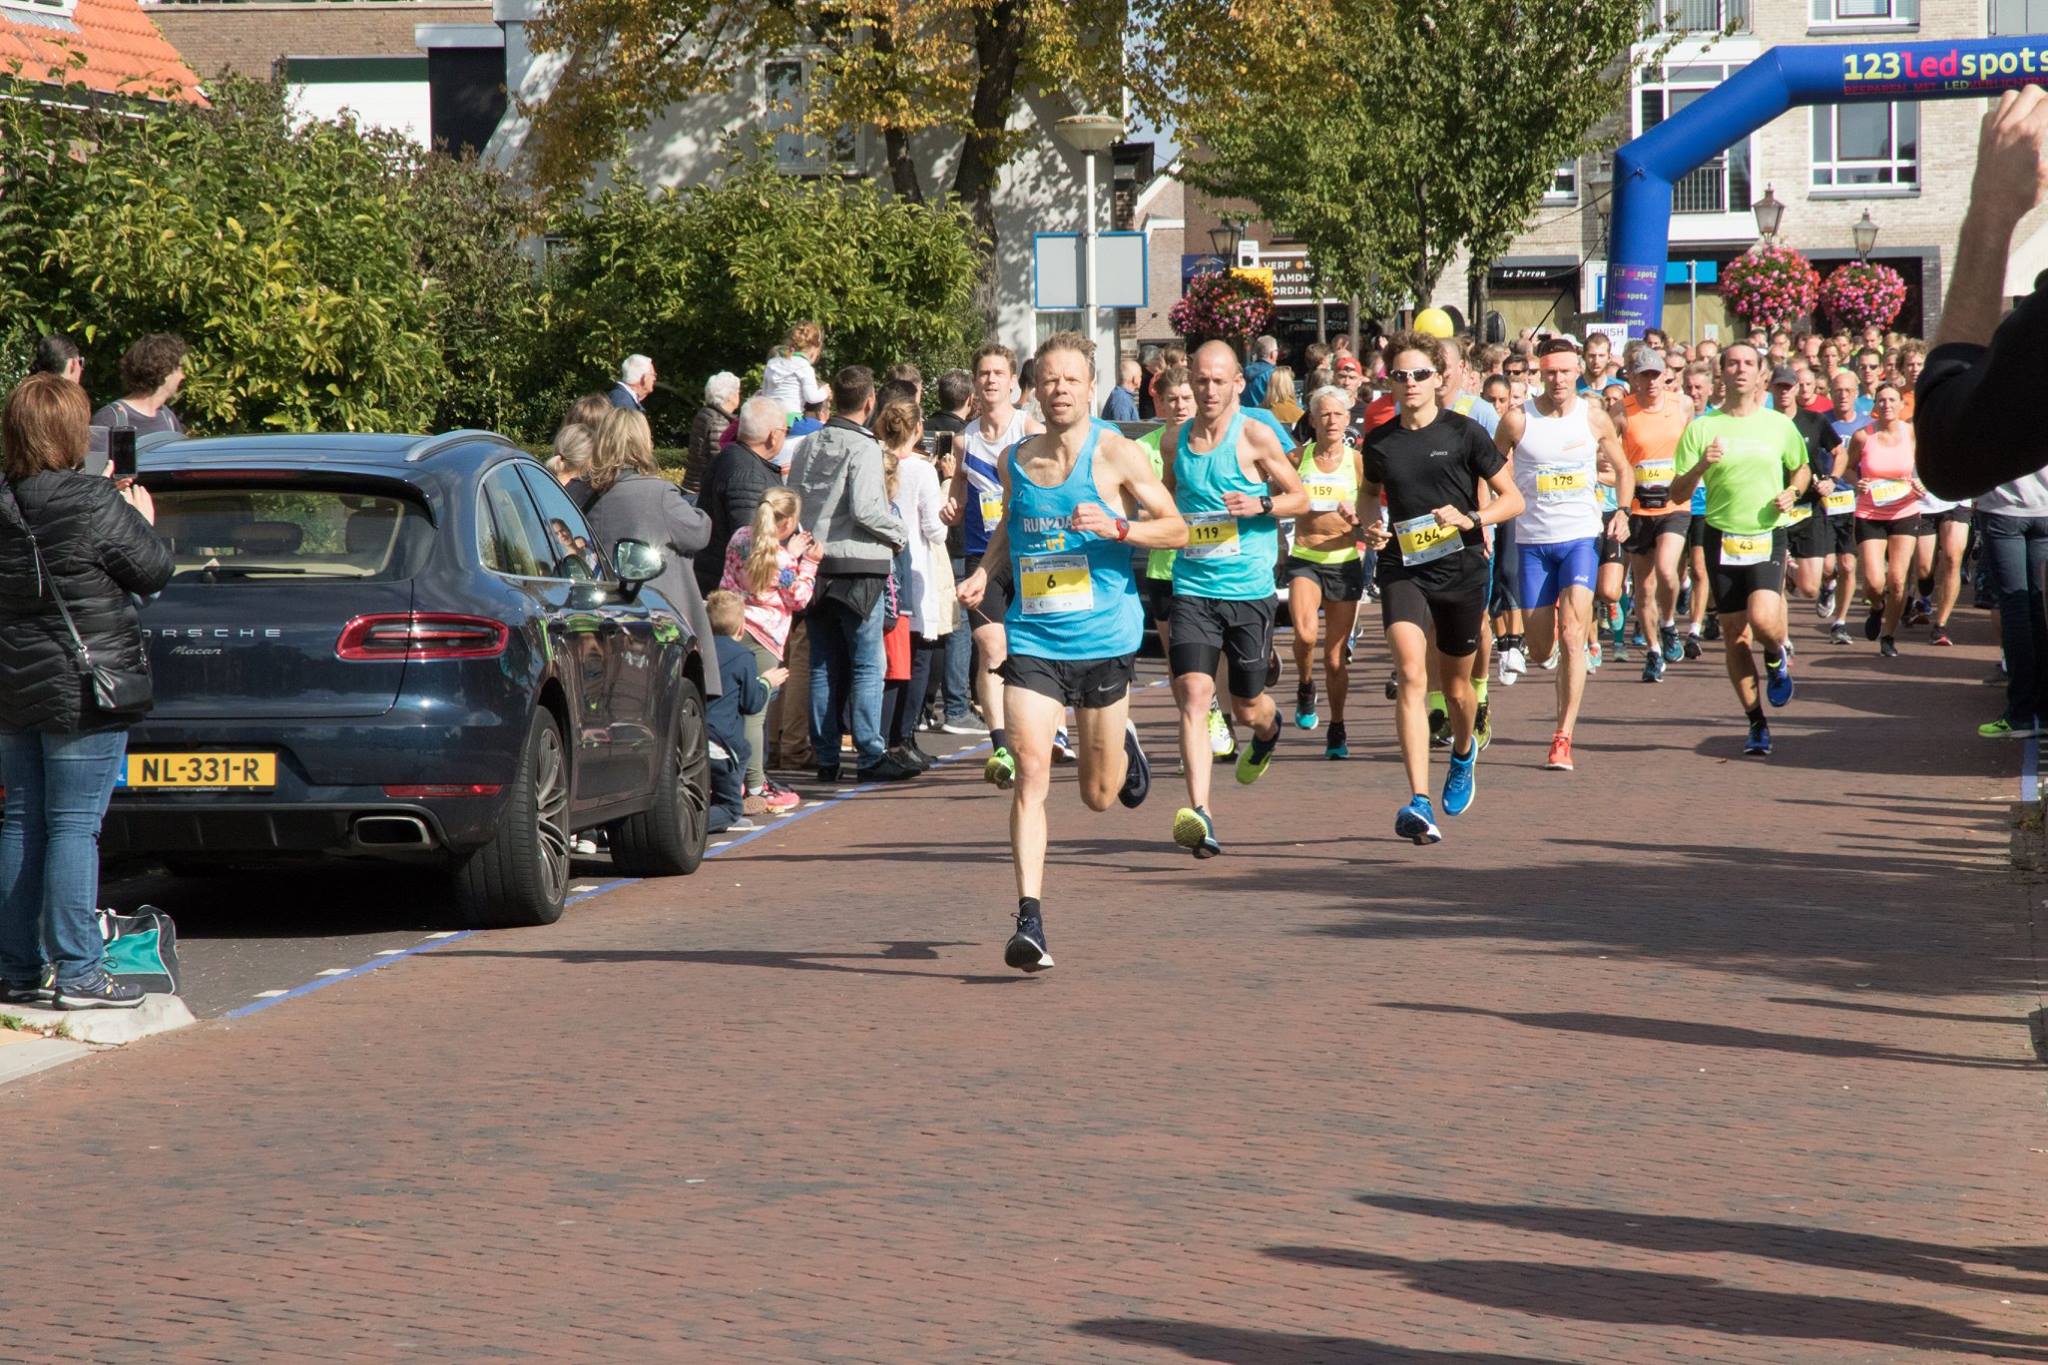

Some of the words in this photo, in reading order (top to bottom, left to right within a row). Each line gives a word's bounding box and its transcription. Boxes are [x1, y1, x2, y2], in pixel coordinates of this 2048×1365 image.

[1263, 261, 1291, 270] VERF
[1312, 486, 1333, 496] 159
[1196, 527, 1219, 540] 119
[1415, 529, 1440, 545] 264
[1046, 574, 1057, 589] 6
[142, 629, 281, 638] ORSCHE
[168, 646, 222, 655] Macan
[142, 758, 260, 782] NL-331-R
